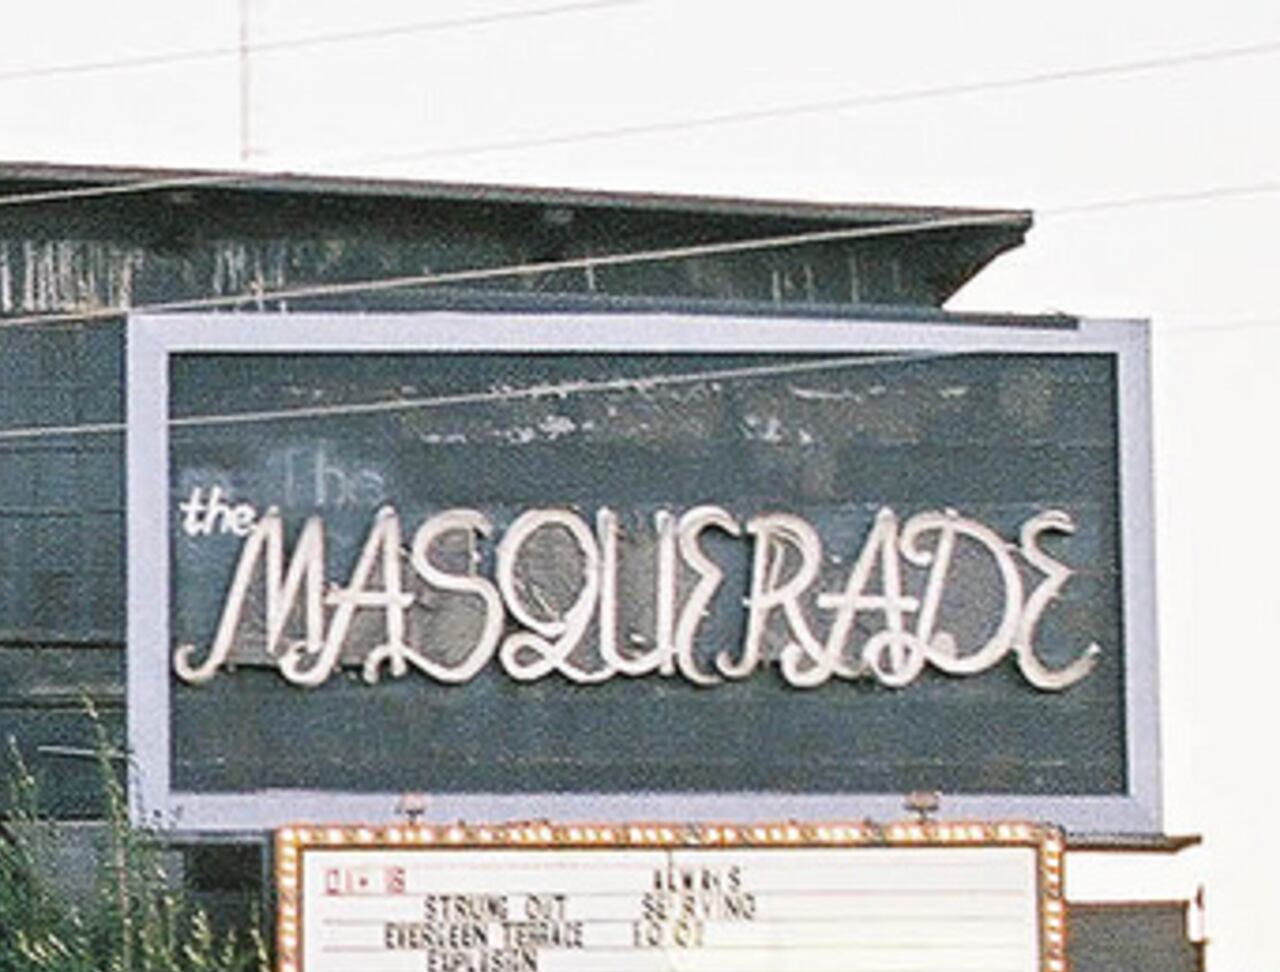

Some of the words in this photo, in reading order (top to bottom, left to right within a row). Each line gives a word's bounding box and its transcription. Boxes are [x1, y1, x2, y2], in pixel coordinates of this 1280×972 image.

[179, 484, 258, 538] the
[174, 504, 1101, 688] MASQUERADE
[424, 895, 508, 920] STRUNG
[525, 894, 565, 920] OUT
